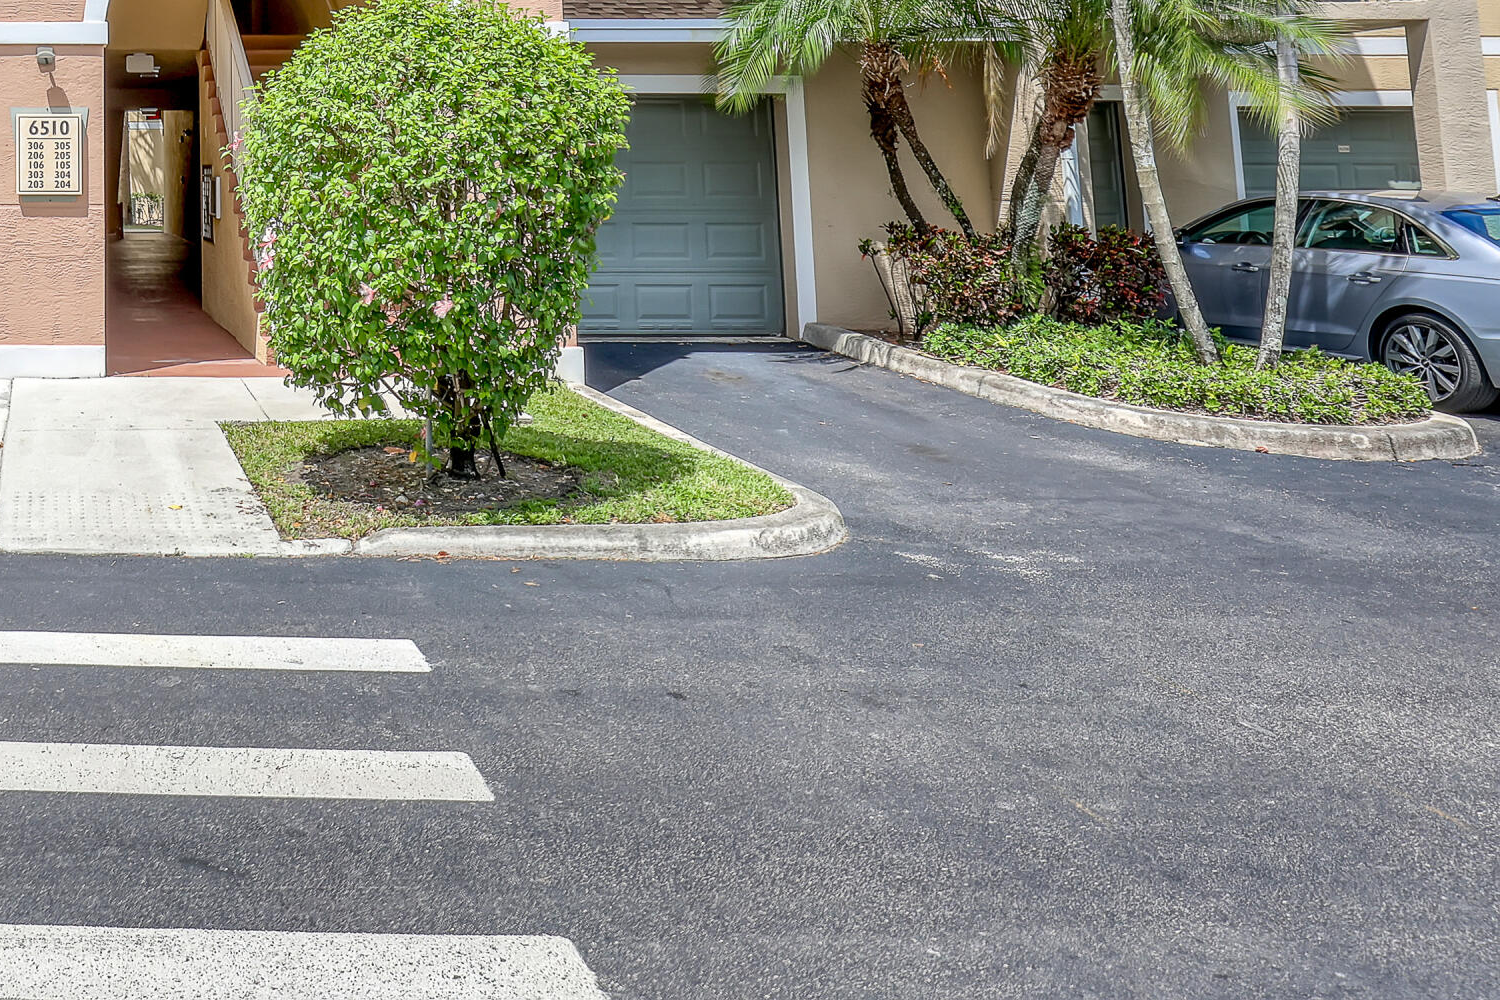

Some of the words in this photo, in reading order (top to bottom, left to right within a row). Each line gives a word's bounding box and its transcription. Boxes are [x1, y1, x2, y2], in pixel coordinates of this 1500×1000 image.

[29, 120, 69, 135] 6510
[27, 141, 45, 150] 306
[54, 141, 71, 150] 305
[27, 151, 45, 160] 206
[54, 151, 71, 160] 205
[29, 161, 45, 169] 106
[55, 161, 71, 169] 105
[27, 170, 45, 179] 303
[54, 170, 71, 179] 304
[27, 180, 45, 189] 203
[54, 180, 71, 189] 204
